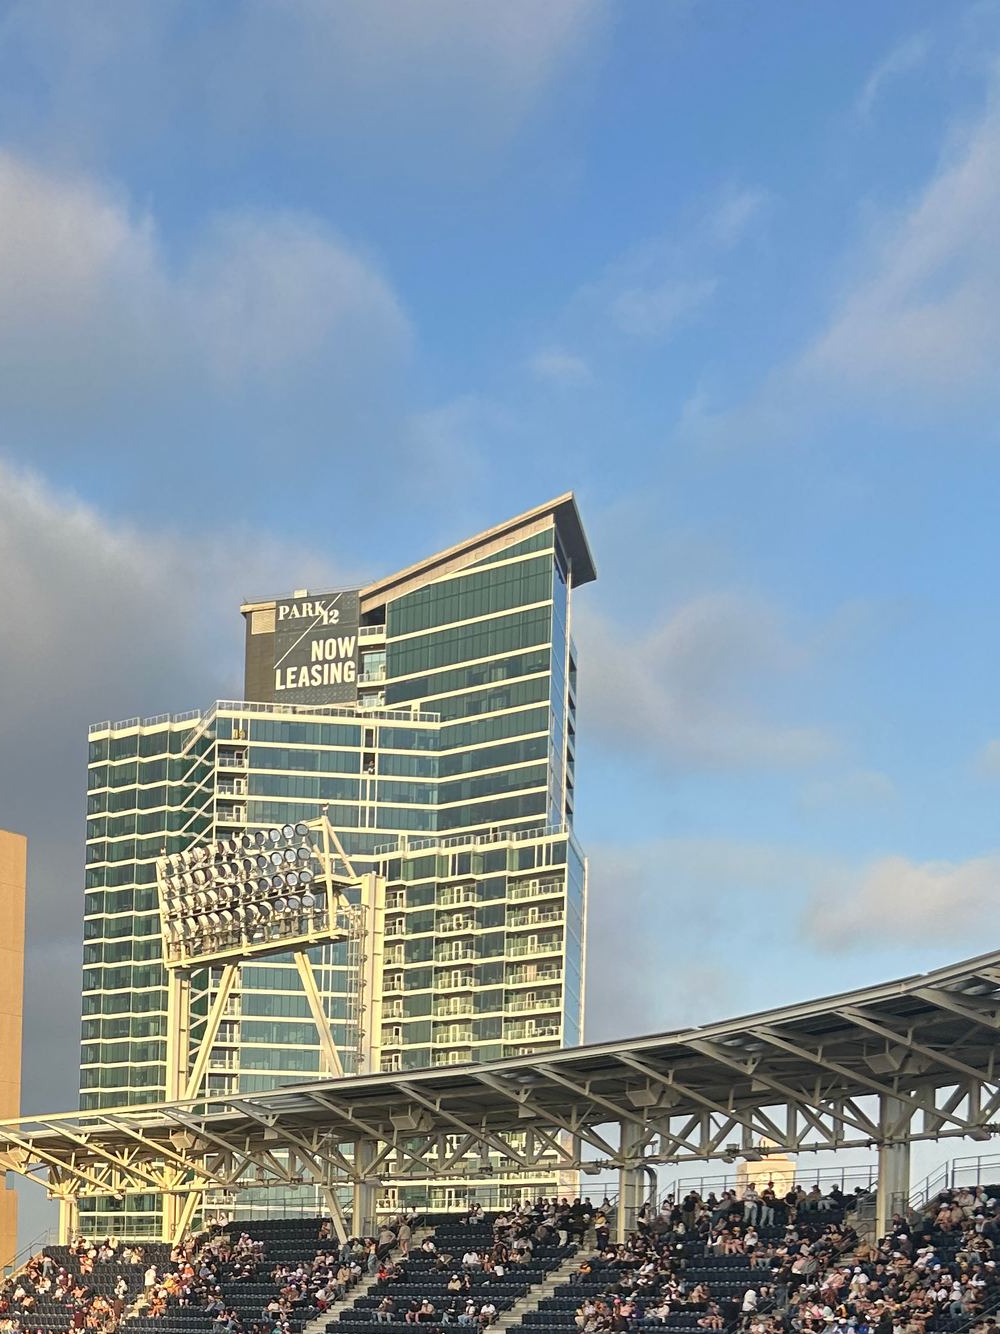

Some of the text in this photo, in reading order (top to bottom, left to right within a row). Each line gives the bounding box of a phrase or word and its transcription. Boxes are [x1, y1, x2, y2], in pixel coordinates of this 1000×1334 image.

[278, 601, 326, 620] PARK
[321, 609, 339, 625] 12
[311, 636, 356, 662] NOW
[275, 661, 356, 691] LEASING
